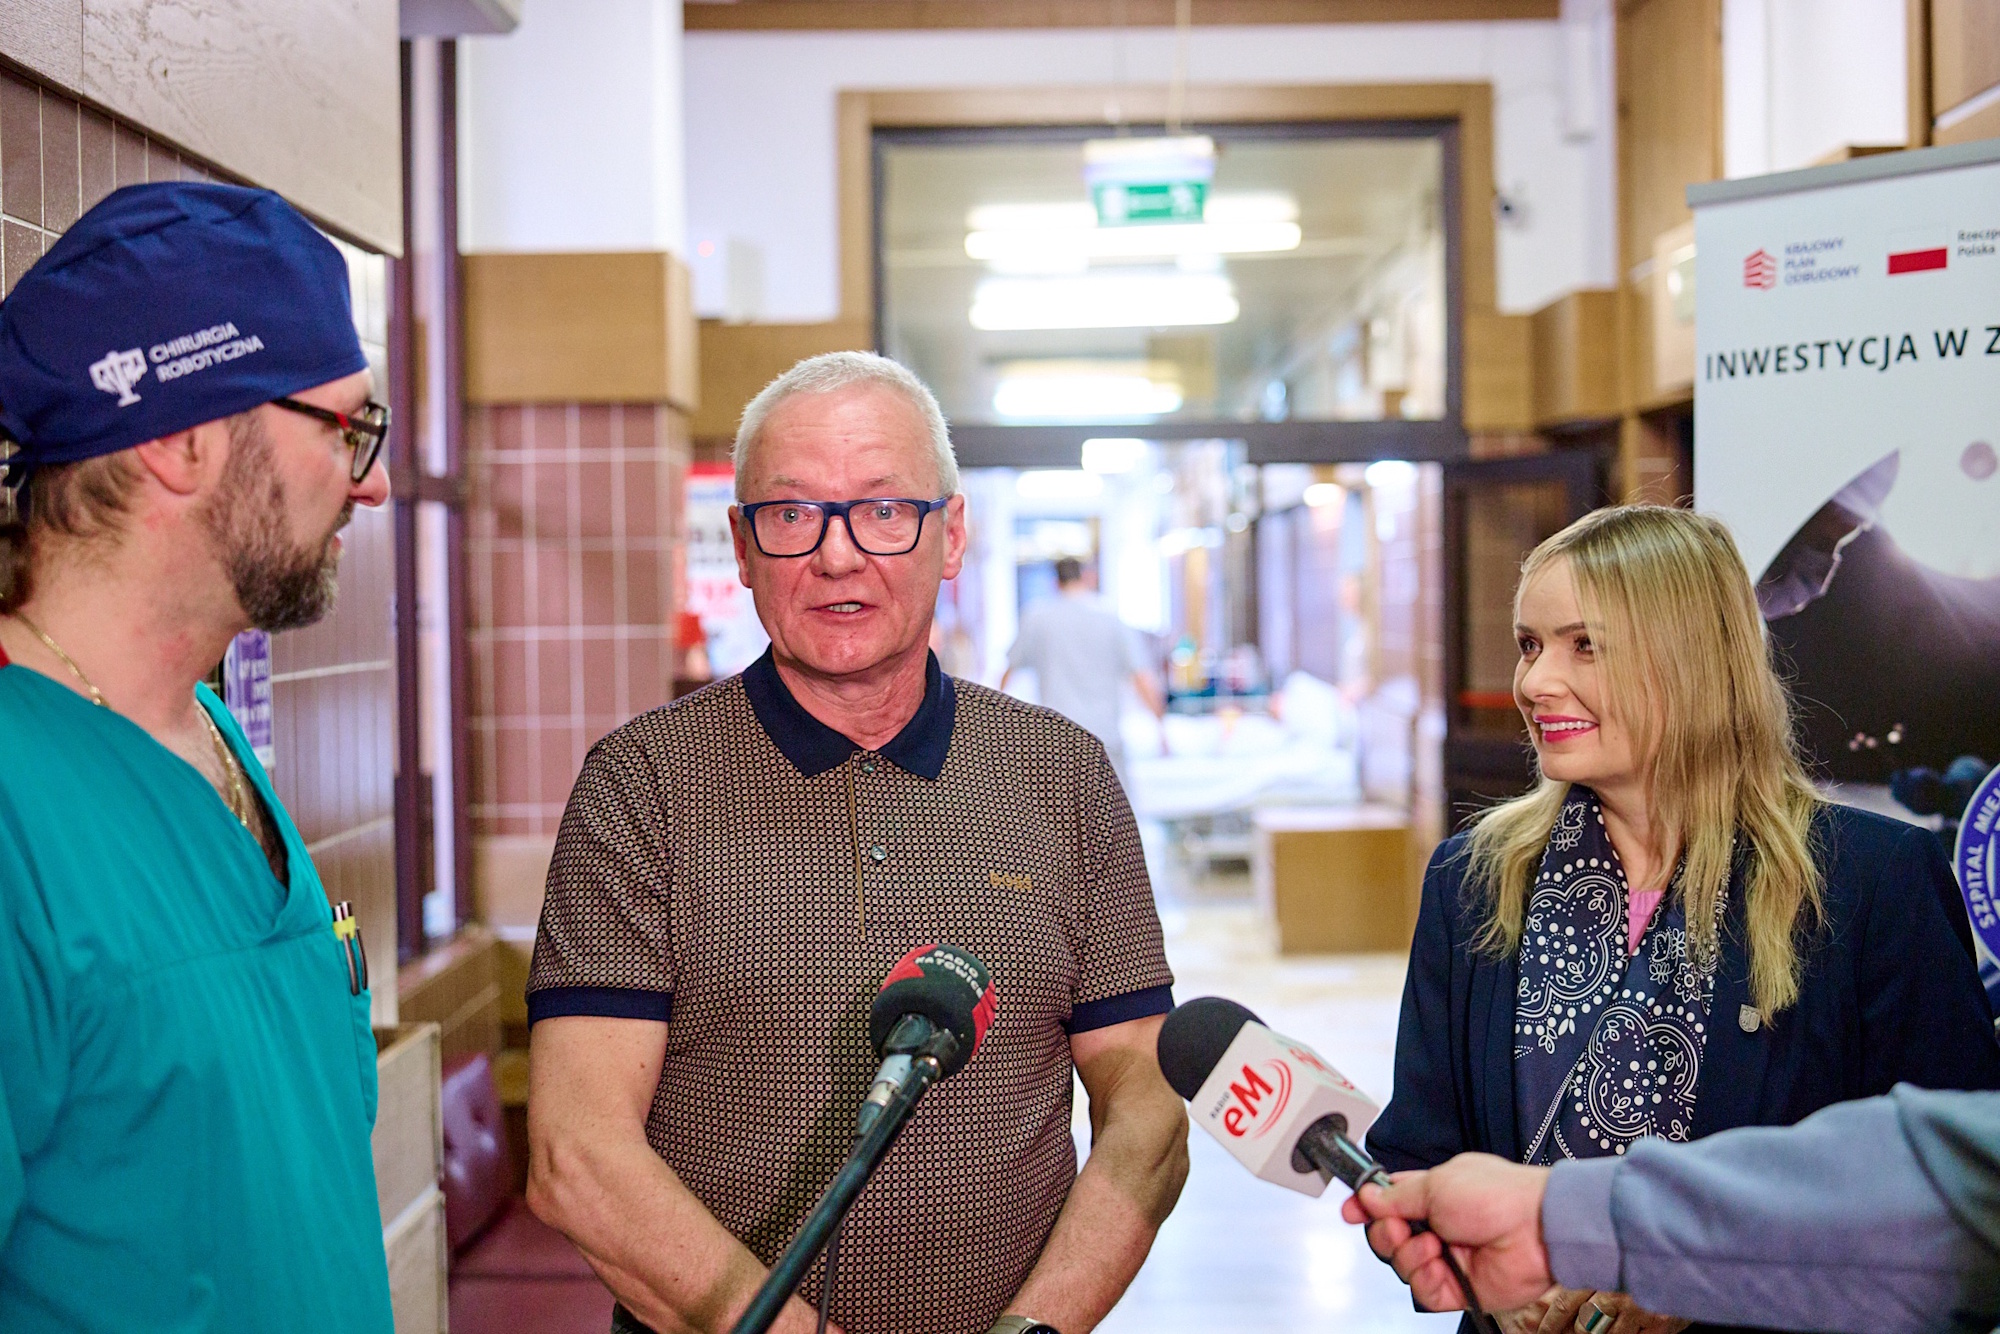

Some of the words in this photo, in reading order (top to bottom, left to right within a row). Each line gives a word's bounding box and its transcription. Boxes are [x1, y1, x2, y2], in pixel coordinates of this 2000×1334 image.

[1784, 237, 1844, 255] KRAJOWY
[1784, 258, 1815, 269] PLAN
[1957, 244, 1996, 257] Polska
[149, 321, 241, 364] CHIRURGIA
[155, 335, 265, 383] ROBOTYCZNA
[1706, 332, 1918, 381] INWESTYCJA
[1933, 327, 1969, 358] W
[1973, 781, 2000, 835] MIEJ
[1966, 844, 1996, 929] SZPITAL
[914, 956, 984, 999] KATOWICE
[934, 950, 979, 979] RADIO
[1223, 1063, 1274, 1138] eM
